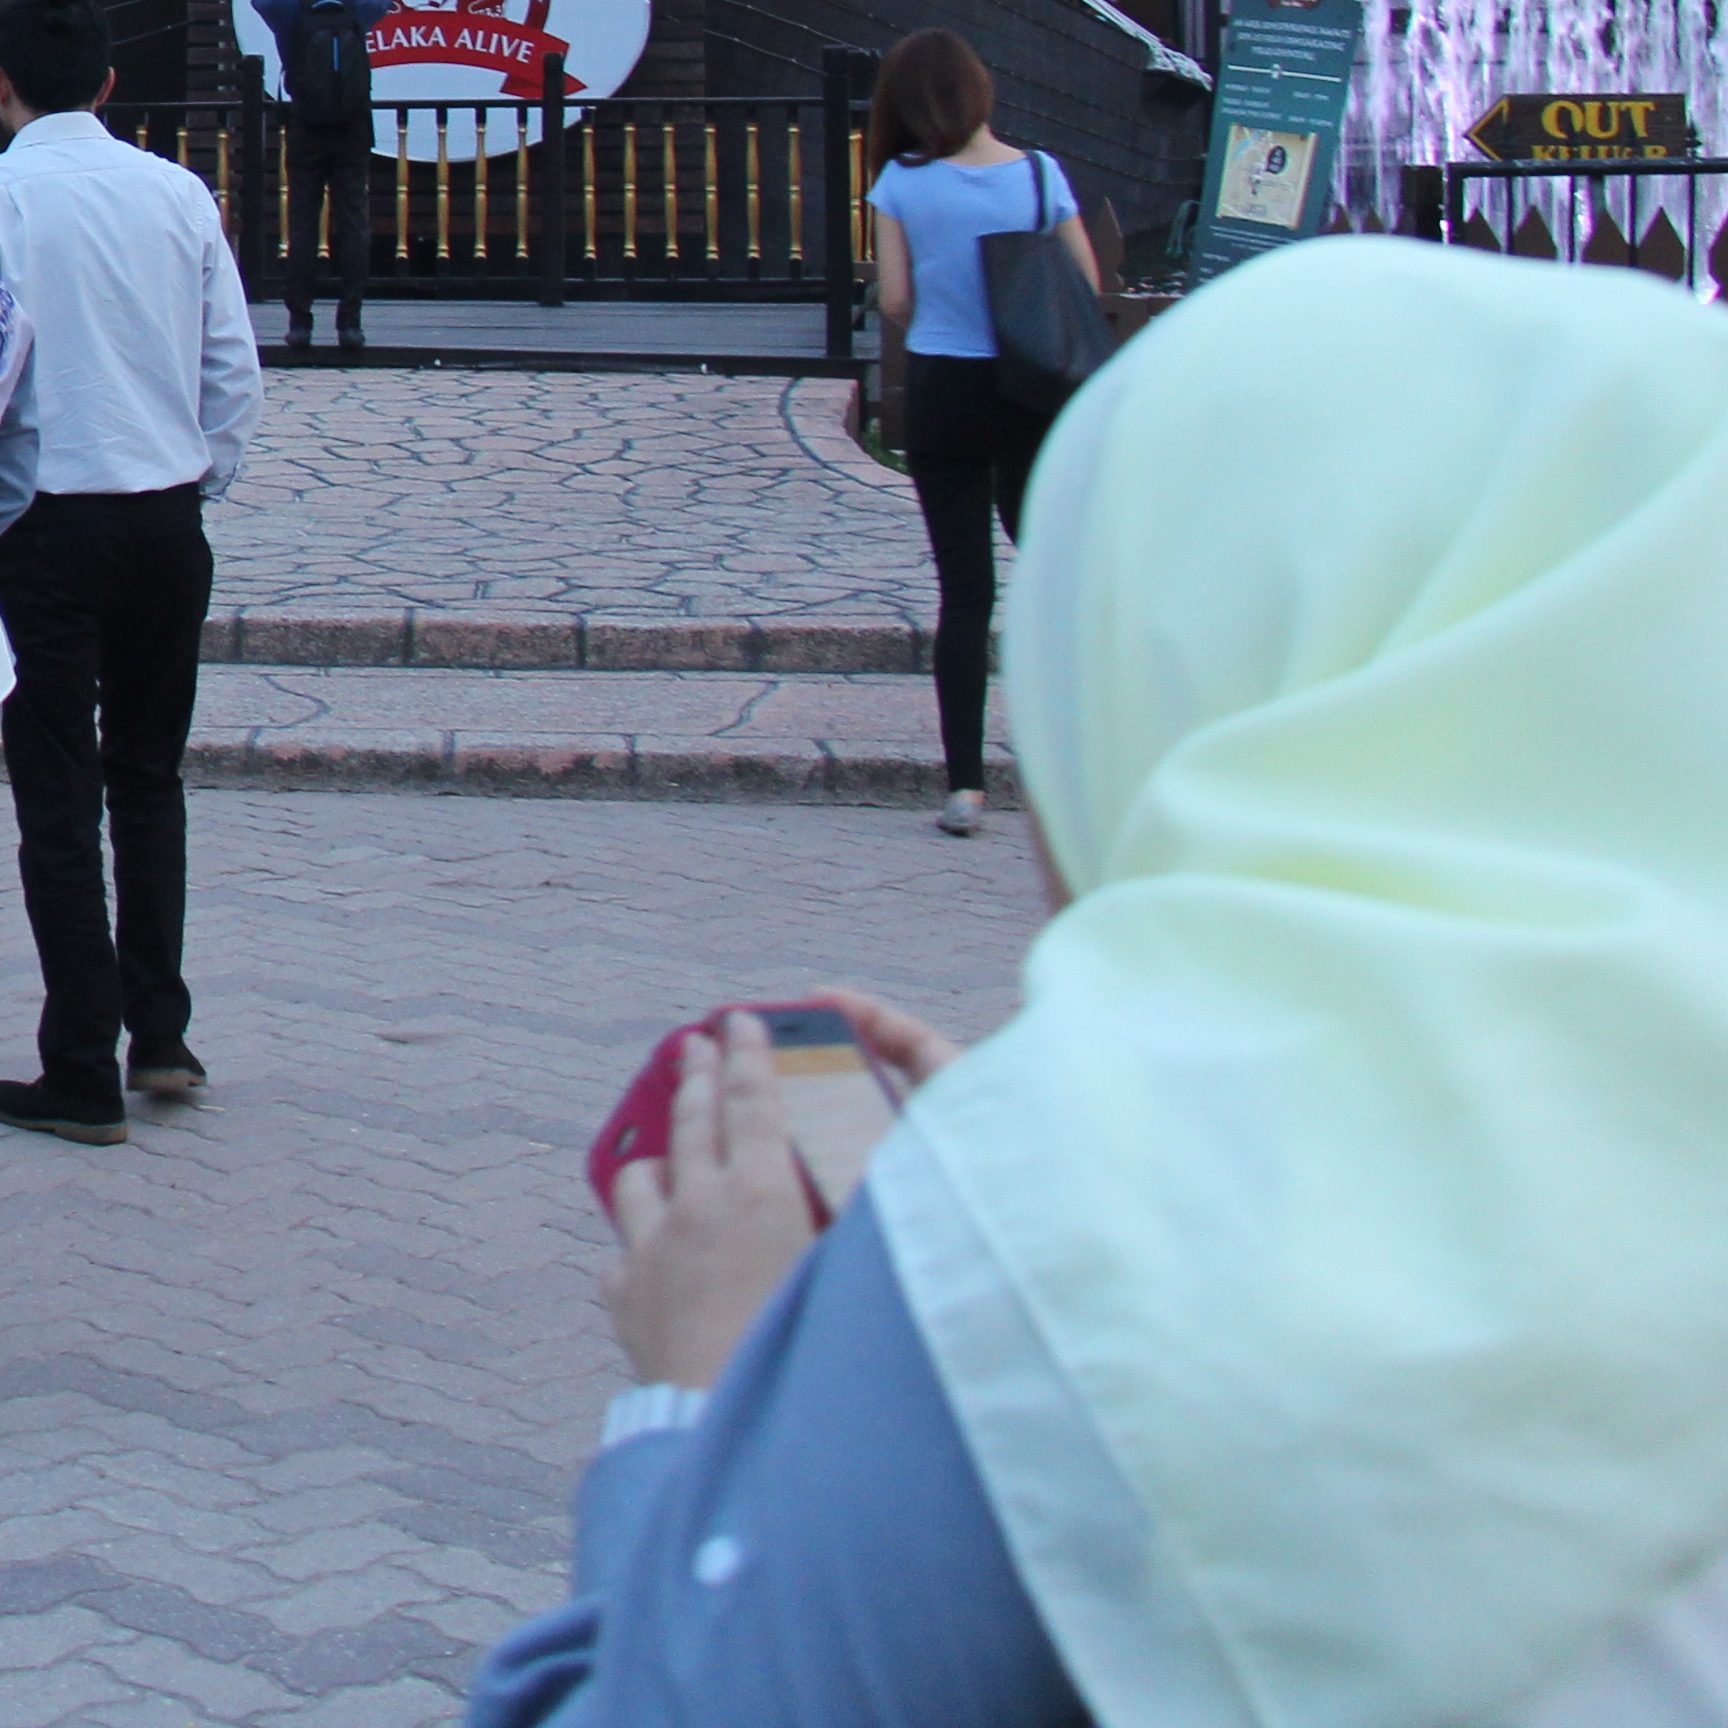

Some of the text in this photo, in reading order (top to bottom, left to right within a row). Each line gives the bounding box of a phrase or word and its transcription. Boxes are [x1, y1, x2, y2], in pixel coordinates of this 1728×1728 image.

[365, 26, 535, 64] ELAKA ALIVE
[1541, 100, 1658, 139] OUT
